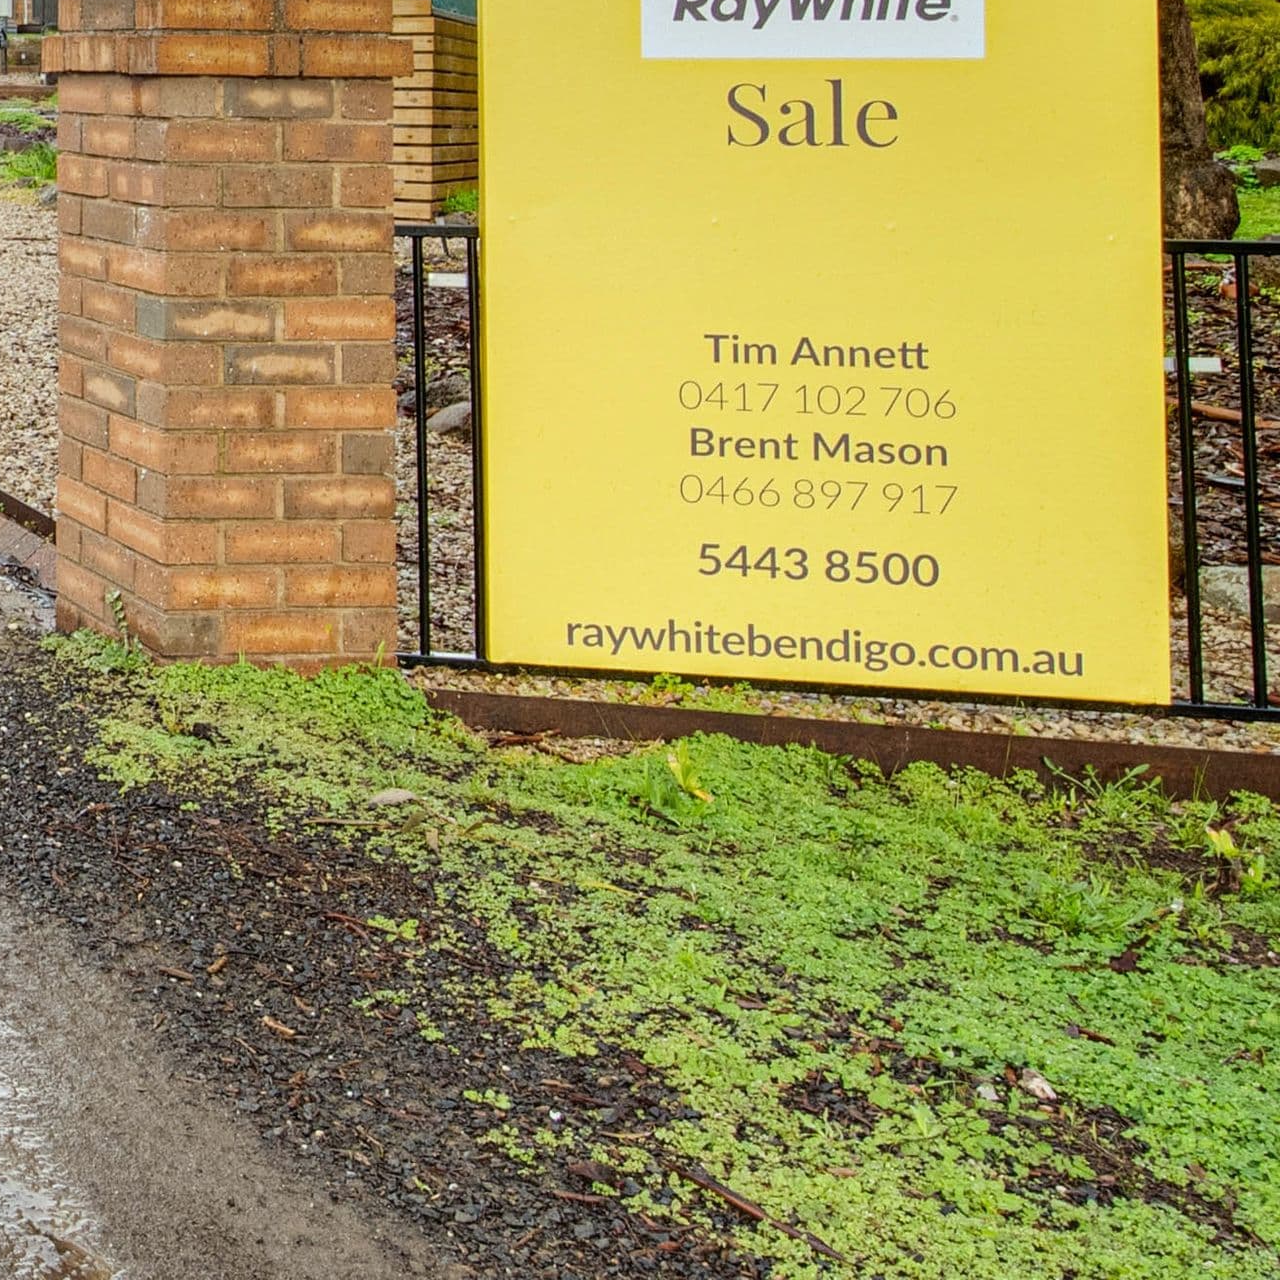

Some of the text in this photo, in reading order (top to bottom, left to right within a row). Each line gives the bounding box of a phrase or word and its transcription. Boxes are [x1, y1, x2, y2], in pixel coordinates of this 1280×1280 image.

[728, 78, 898, 148] Sale
[704, 333, 930, 369] Tim Annett
[678, 380, 957, 419] 0417 102 706
[690, 427, 948, 466] Brent Mason
[679, 474, 959, 515] 0466 897 917
[698, 543, 940, 587] 5443 8500
[566, 618, 1085, 677] raywhitebendigo.com.au
